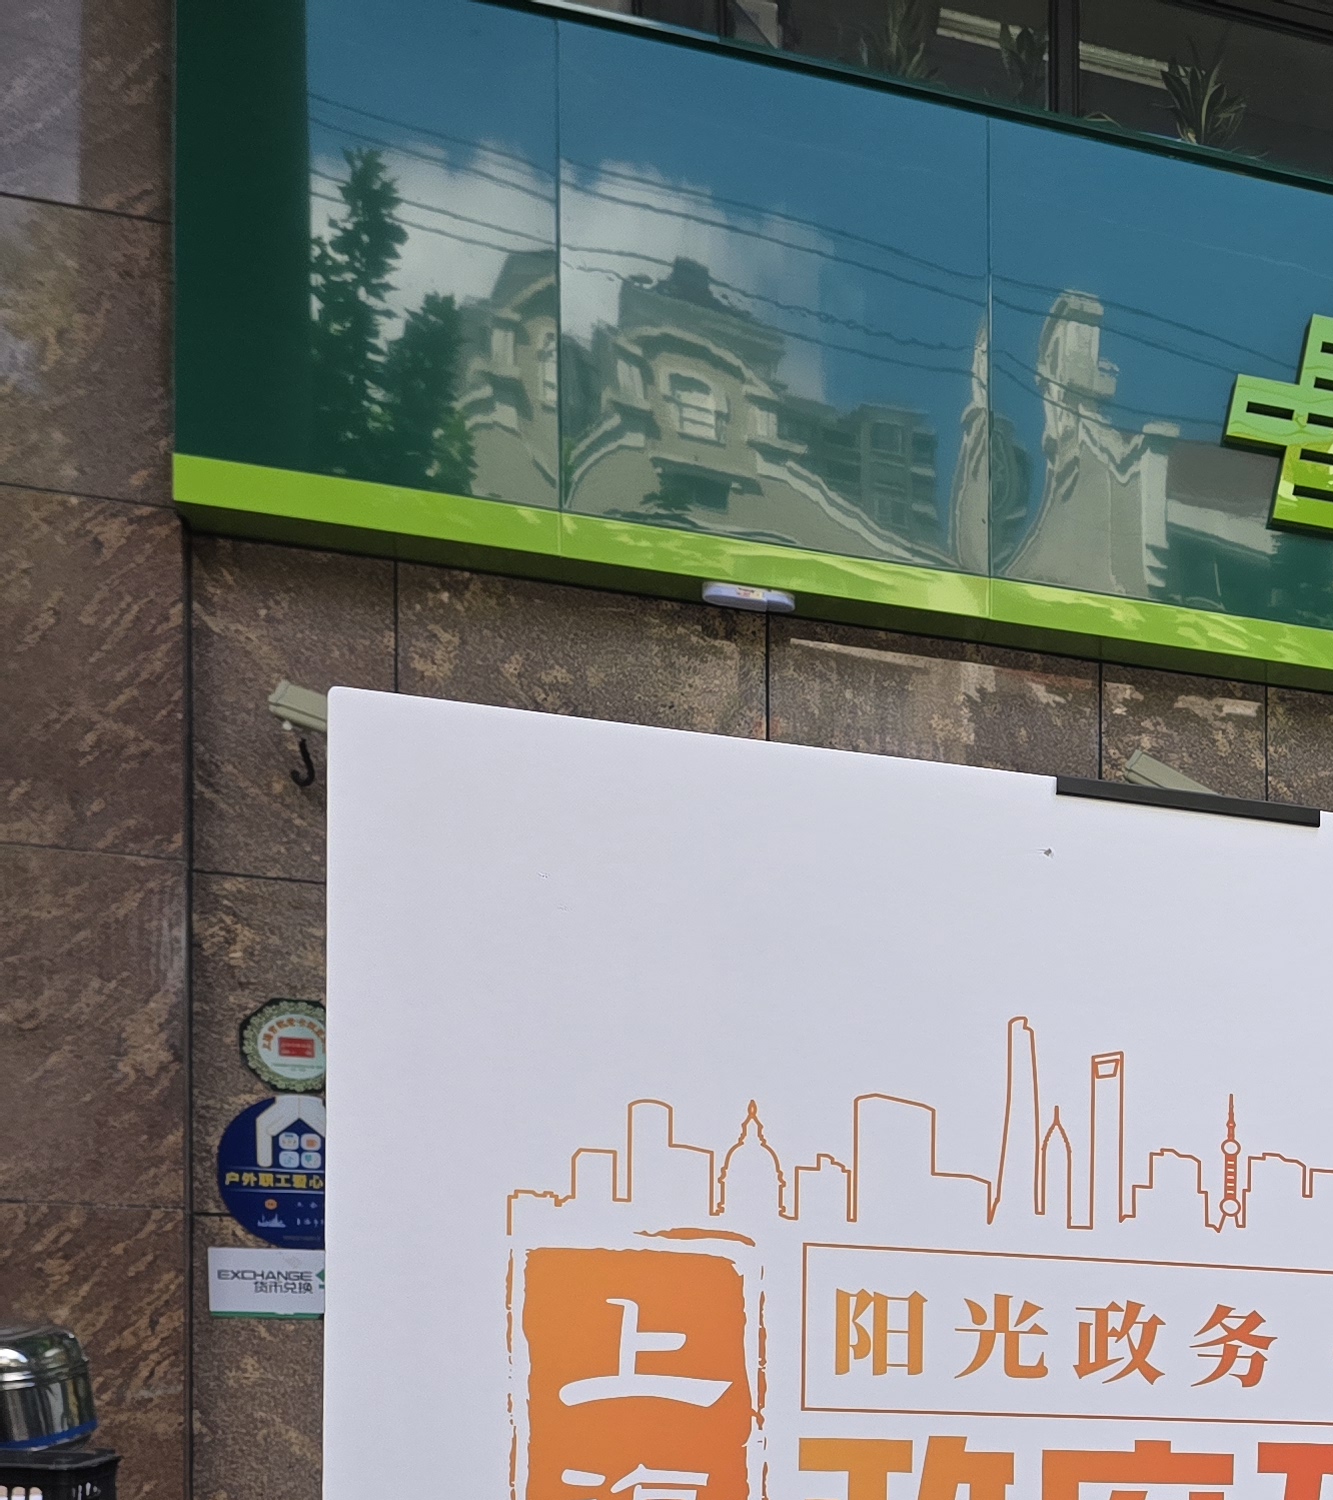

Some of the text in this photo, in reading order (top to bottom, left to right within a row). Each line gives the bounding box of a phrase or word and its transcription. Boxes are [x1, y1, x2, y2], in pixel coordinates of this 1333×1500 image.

[216, 1269, 313, 1281] EXCHANGE
[254, 1281, 313, 1294] 货币兑换
